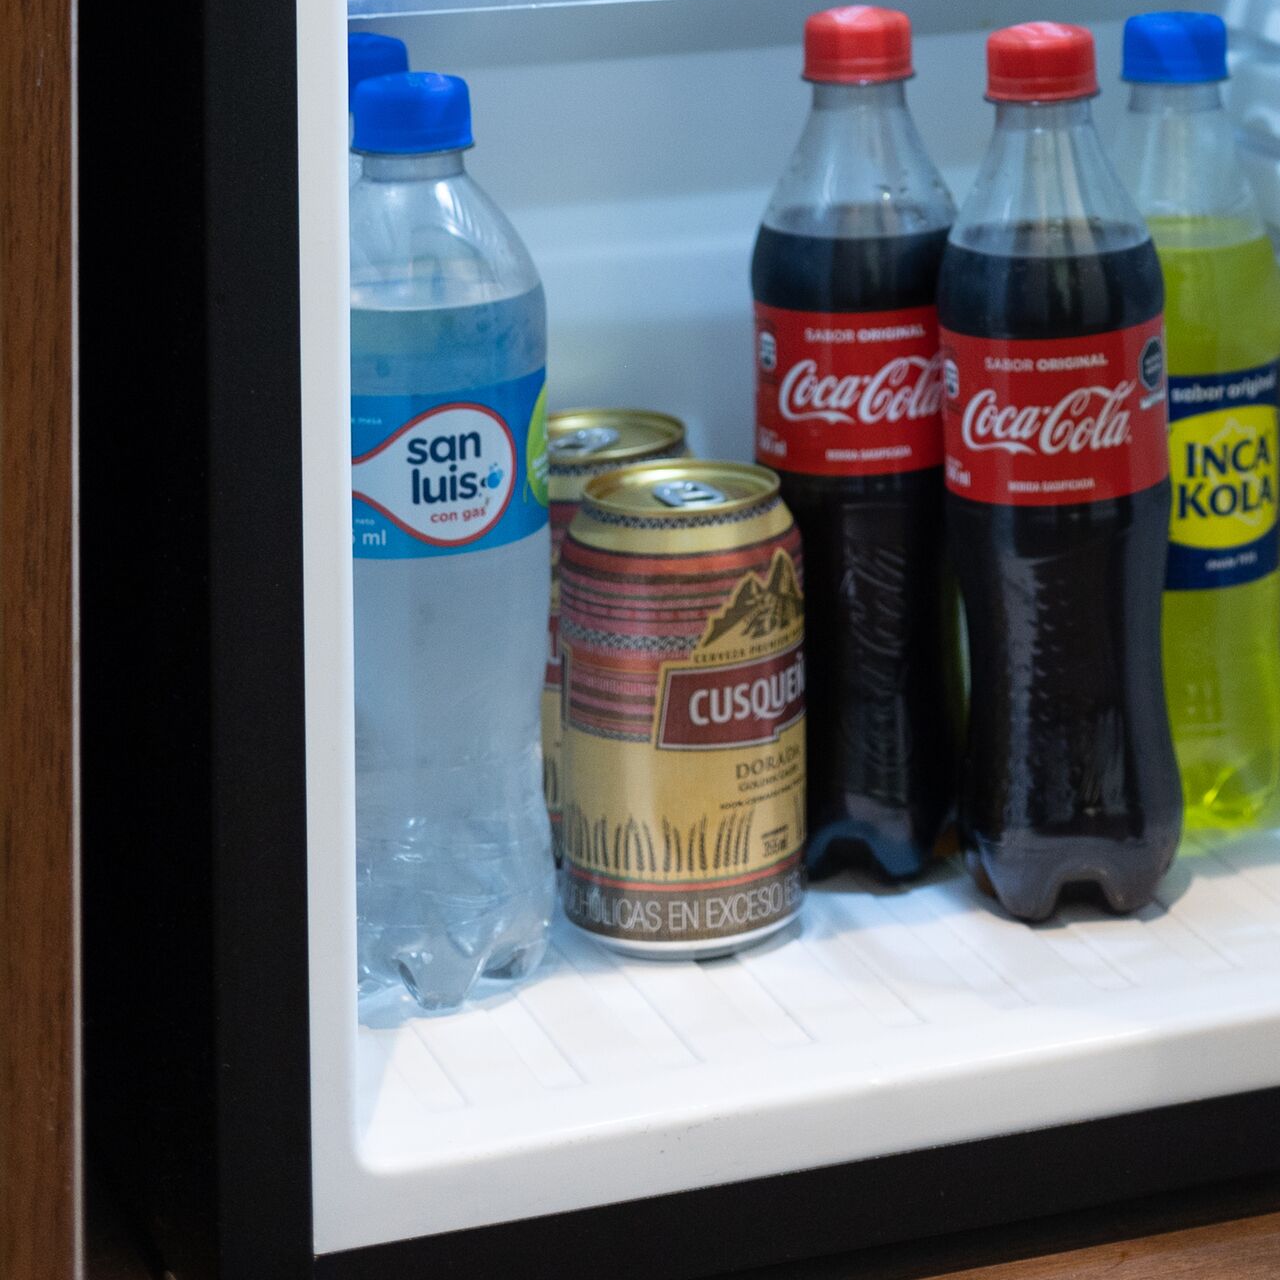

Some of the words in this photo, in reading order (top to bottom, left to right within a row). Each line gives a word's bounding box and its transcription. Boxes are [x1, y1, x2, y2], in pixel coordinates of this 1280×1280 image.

[804, 326, 855, 344] SABOR
[857, 323, 926, 343] ORIGINAL
[984, 356, 1033, 372] SABOR
[1036, 352, 1108, 371] ORIGINAL
[406, 431, 481, 465] san
[1186, 436, 1271, 479] INCA
[412, 465, 477, 505] luis
[1177, 474, 1275, 520] KOLA
[430, 509, 458, 524] con
[463, 506, 486, 522] gas
[362, 529, 387, 546] ml
[668, 901, 699, 931] EN
[705, 883, 783, 929] EXCESO
